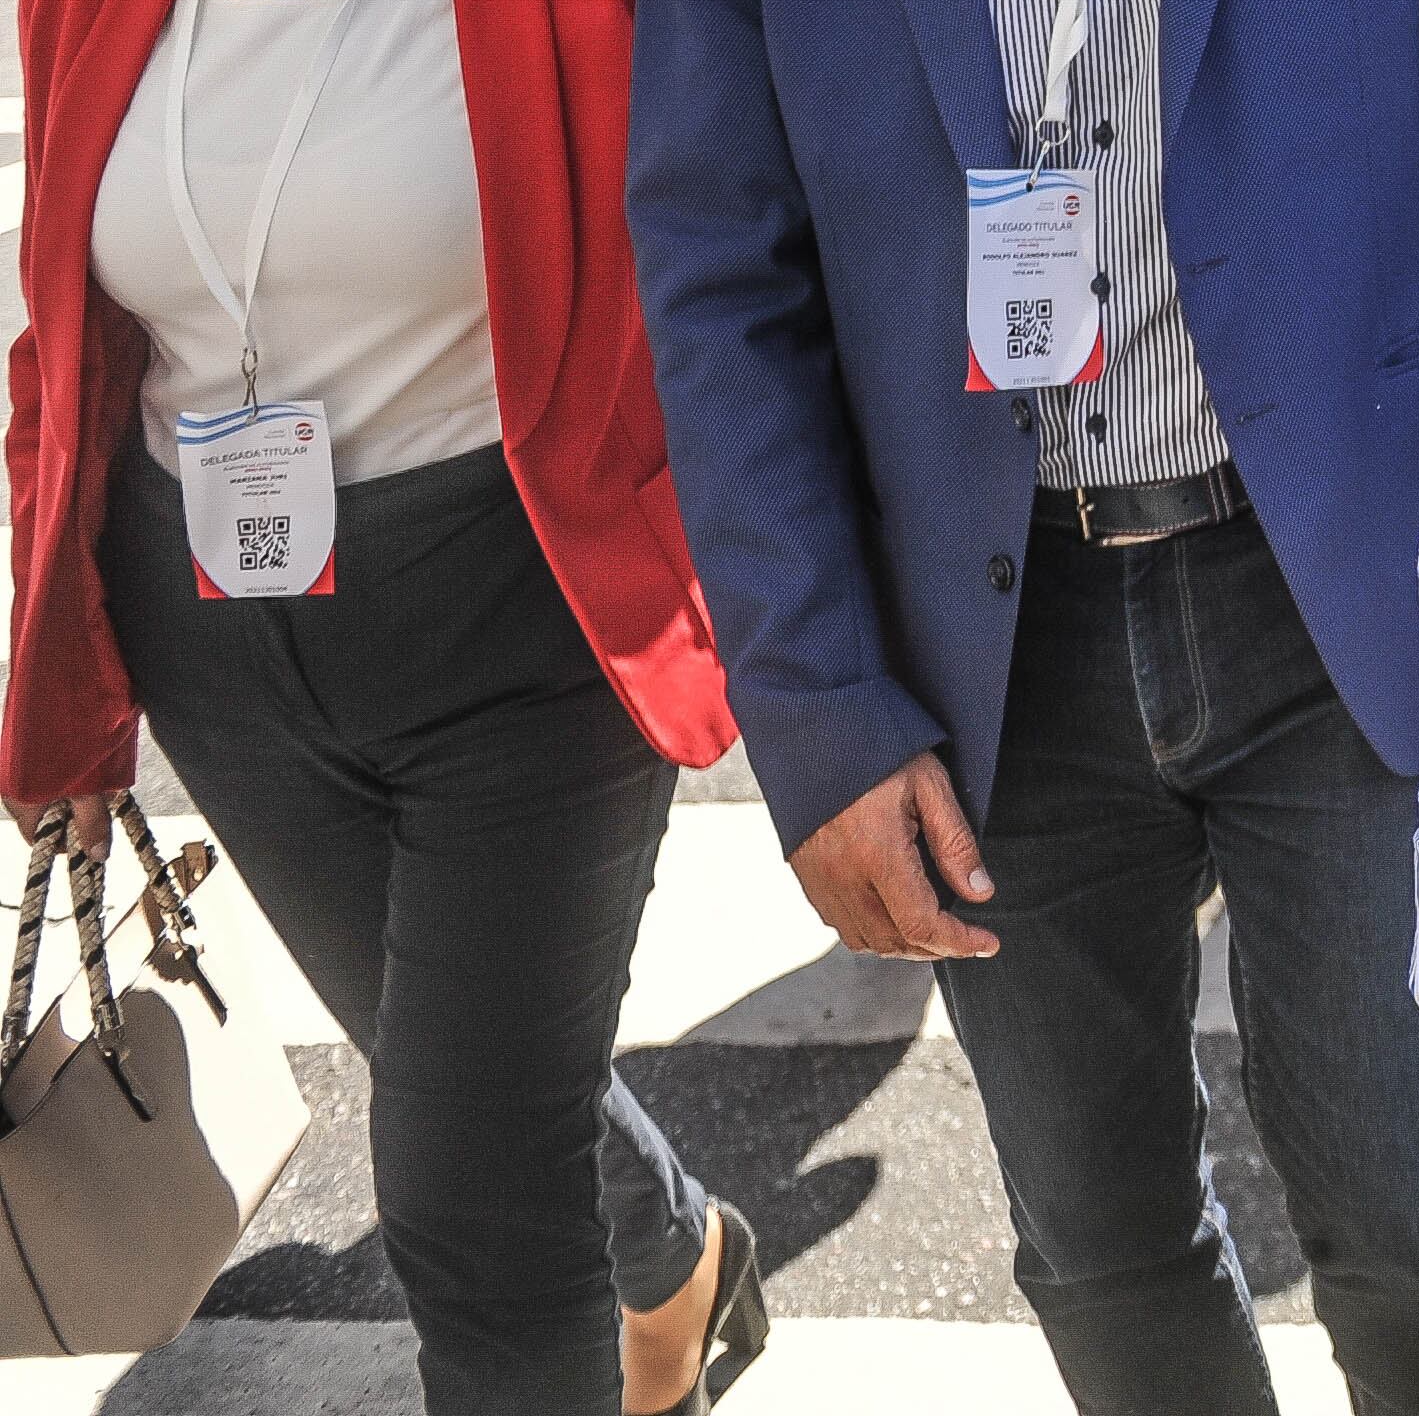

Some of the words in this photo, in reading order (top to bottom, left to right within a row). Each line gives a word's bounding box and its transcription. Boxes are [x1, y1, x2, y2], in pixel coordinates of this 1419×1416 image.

[986, 222, 1032, 233] DELEGADO
[1034, 221, 1073, 232] TITULAR
[200, 449, 260, 467] DELEGADA
[261, 446, 308, 457] TITULAR
